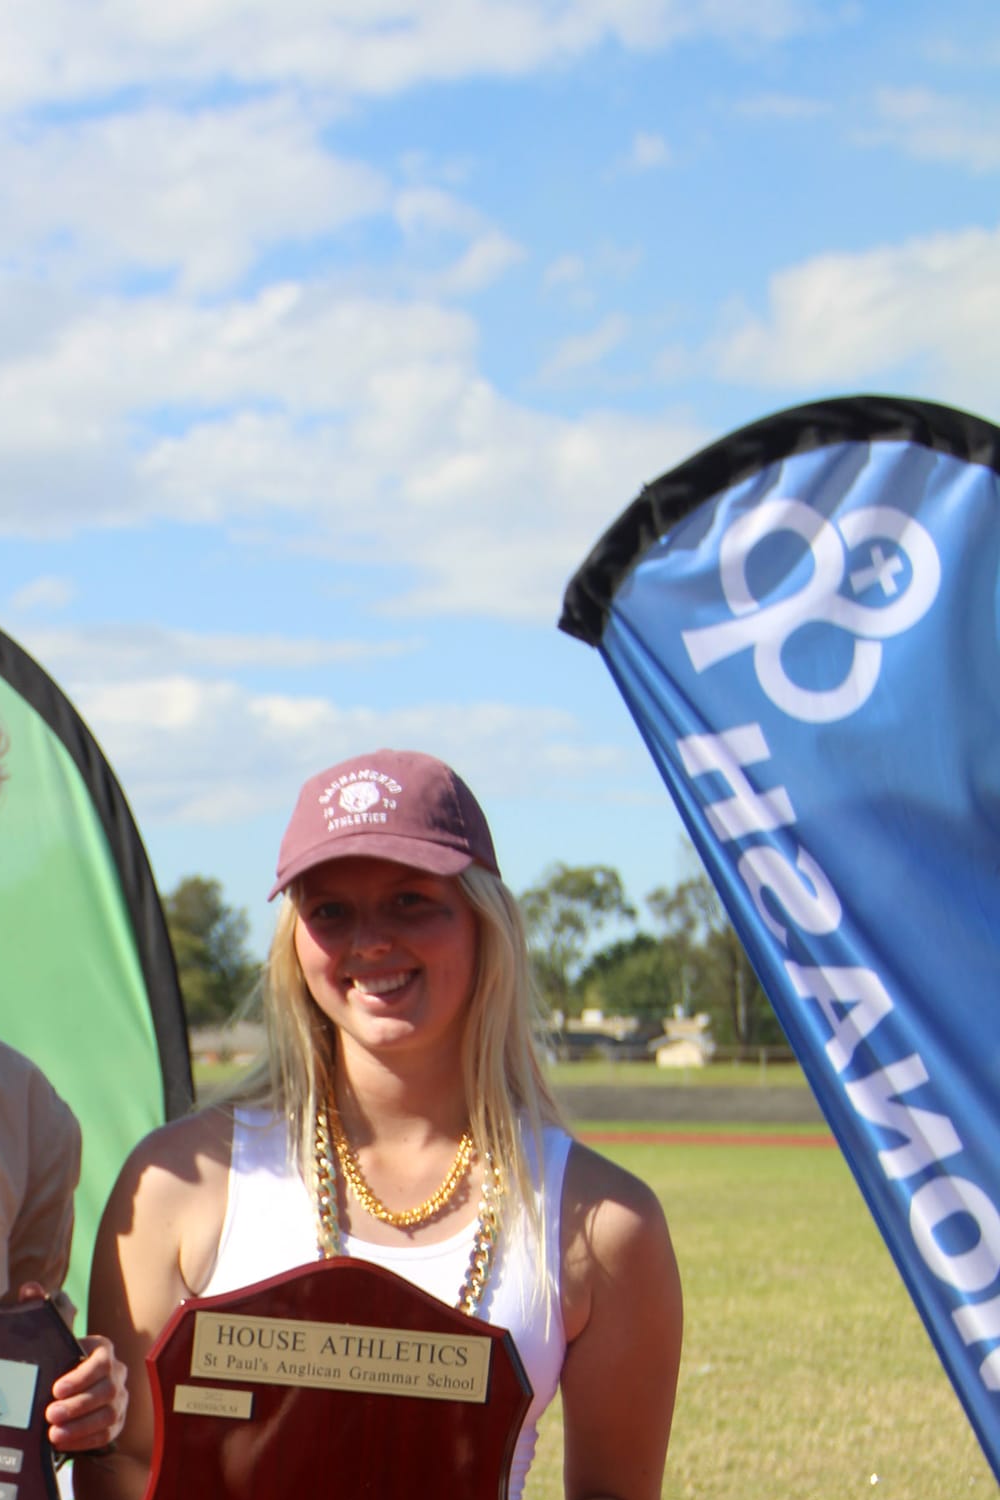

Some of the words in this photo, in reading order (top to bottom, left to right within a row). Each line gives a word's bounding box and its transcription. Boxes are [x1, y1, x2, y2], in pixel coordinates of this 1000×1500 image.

[327, 812, 387, 832] ATHLETICS
[216, 1324, 307, 1353] HOUSE
[319, 1335, 469, 1367] ATHLETICS
[203, 1353, 218, 1367] St
[226, 1357, 269, 1373] Paul's
[276, 1360, 342, 1381] Anglican
[349, 1367, 420, 1387] Grammar
[427, 1373, 475, 1391] School
